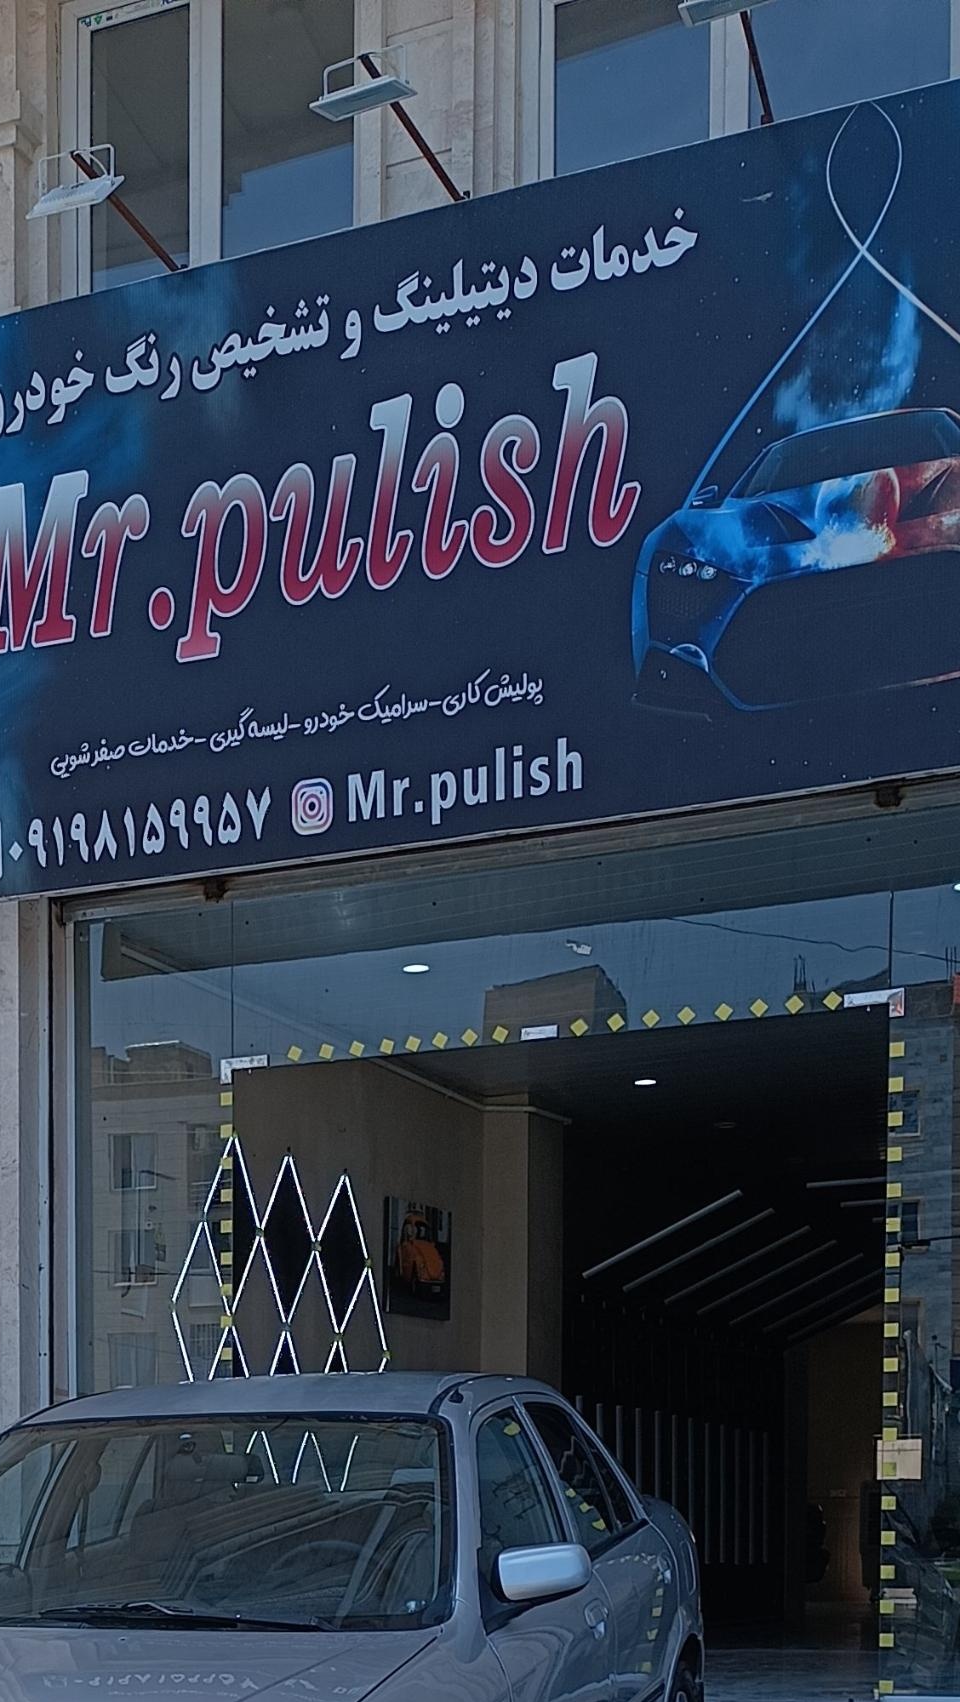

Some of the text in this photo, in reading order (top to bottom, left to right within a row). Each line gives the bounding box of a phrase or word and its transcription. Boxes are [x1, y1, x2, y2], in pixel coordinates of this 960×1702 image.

[550, 207, 699, 292] خدمات
[340, 309, 362, 360] و
[373, 255, 538, 335] دیتیلینگ
[105, 332, 182, 401] رنگ
[192, 294, 330, 391] تشخیص
[484, 672, 543, 706] پولیش
[347, 737, 583, 825] Mr.pulish
[8, 786, 271, 868] ۰۹۱۹۸۱۵۹۹۵۷
